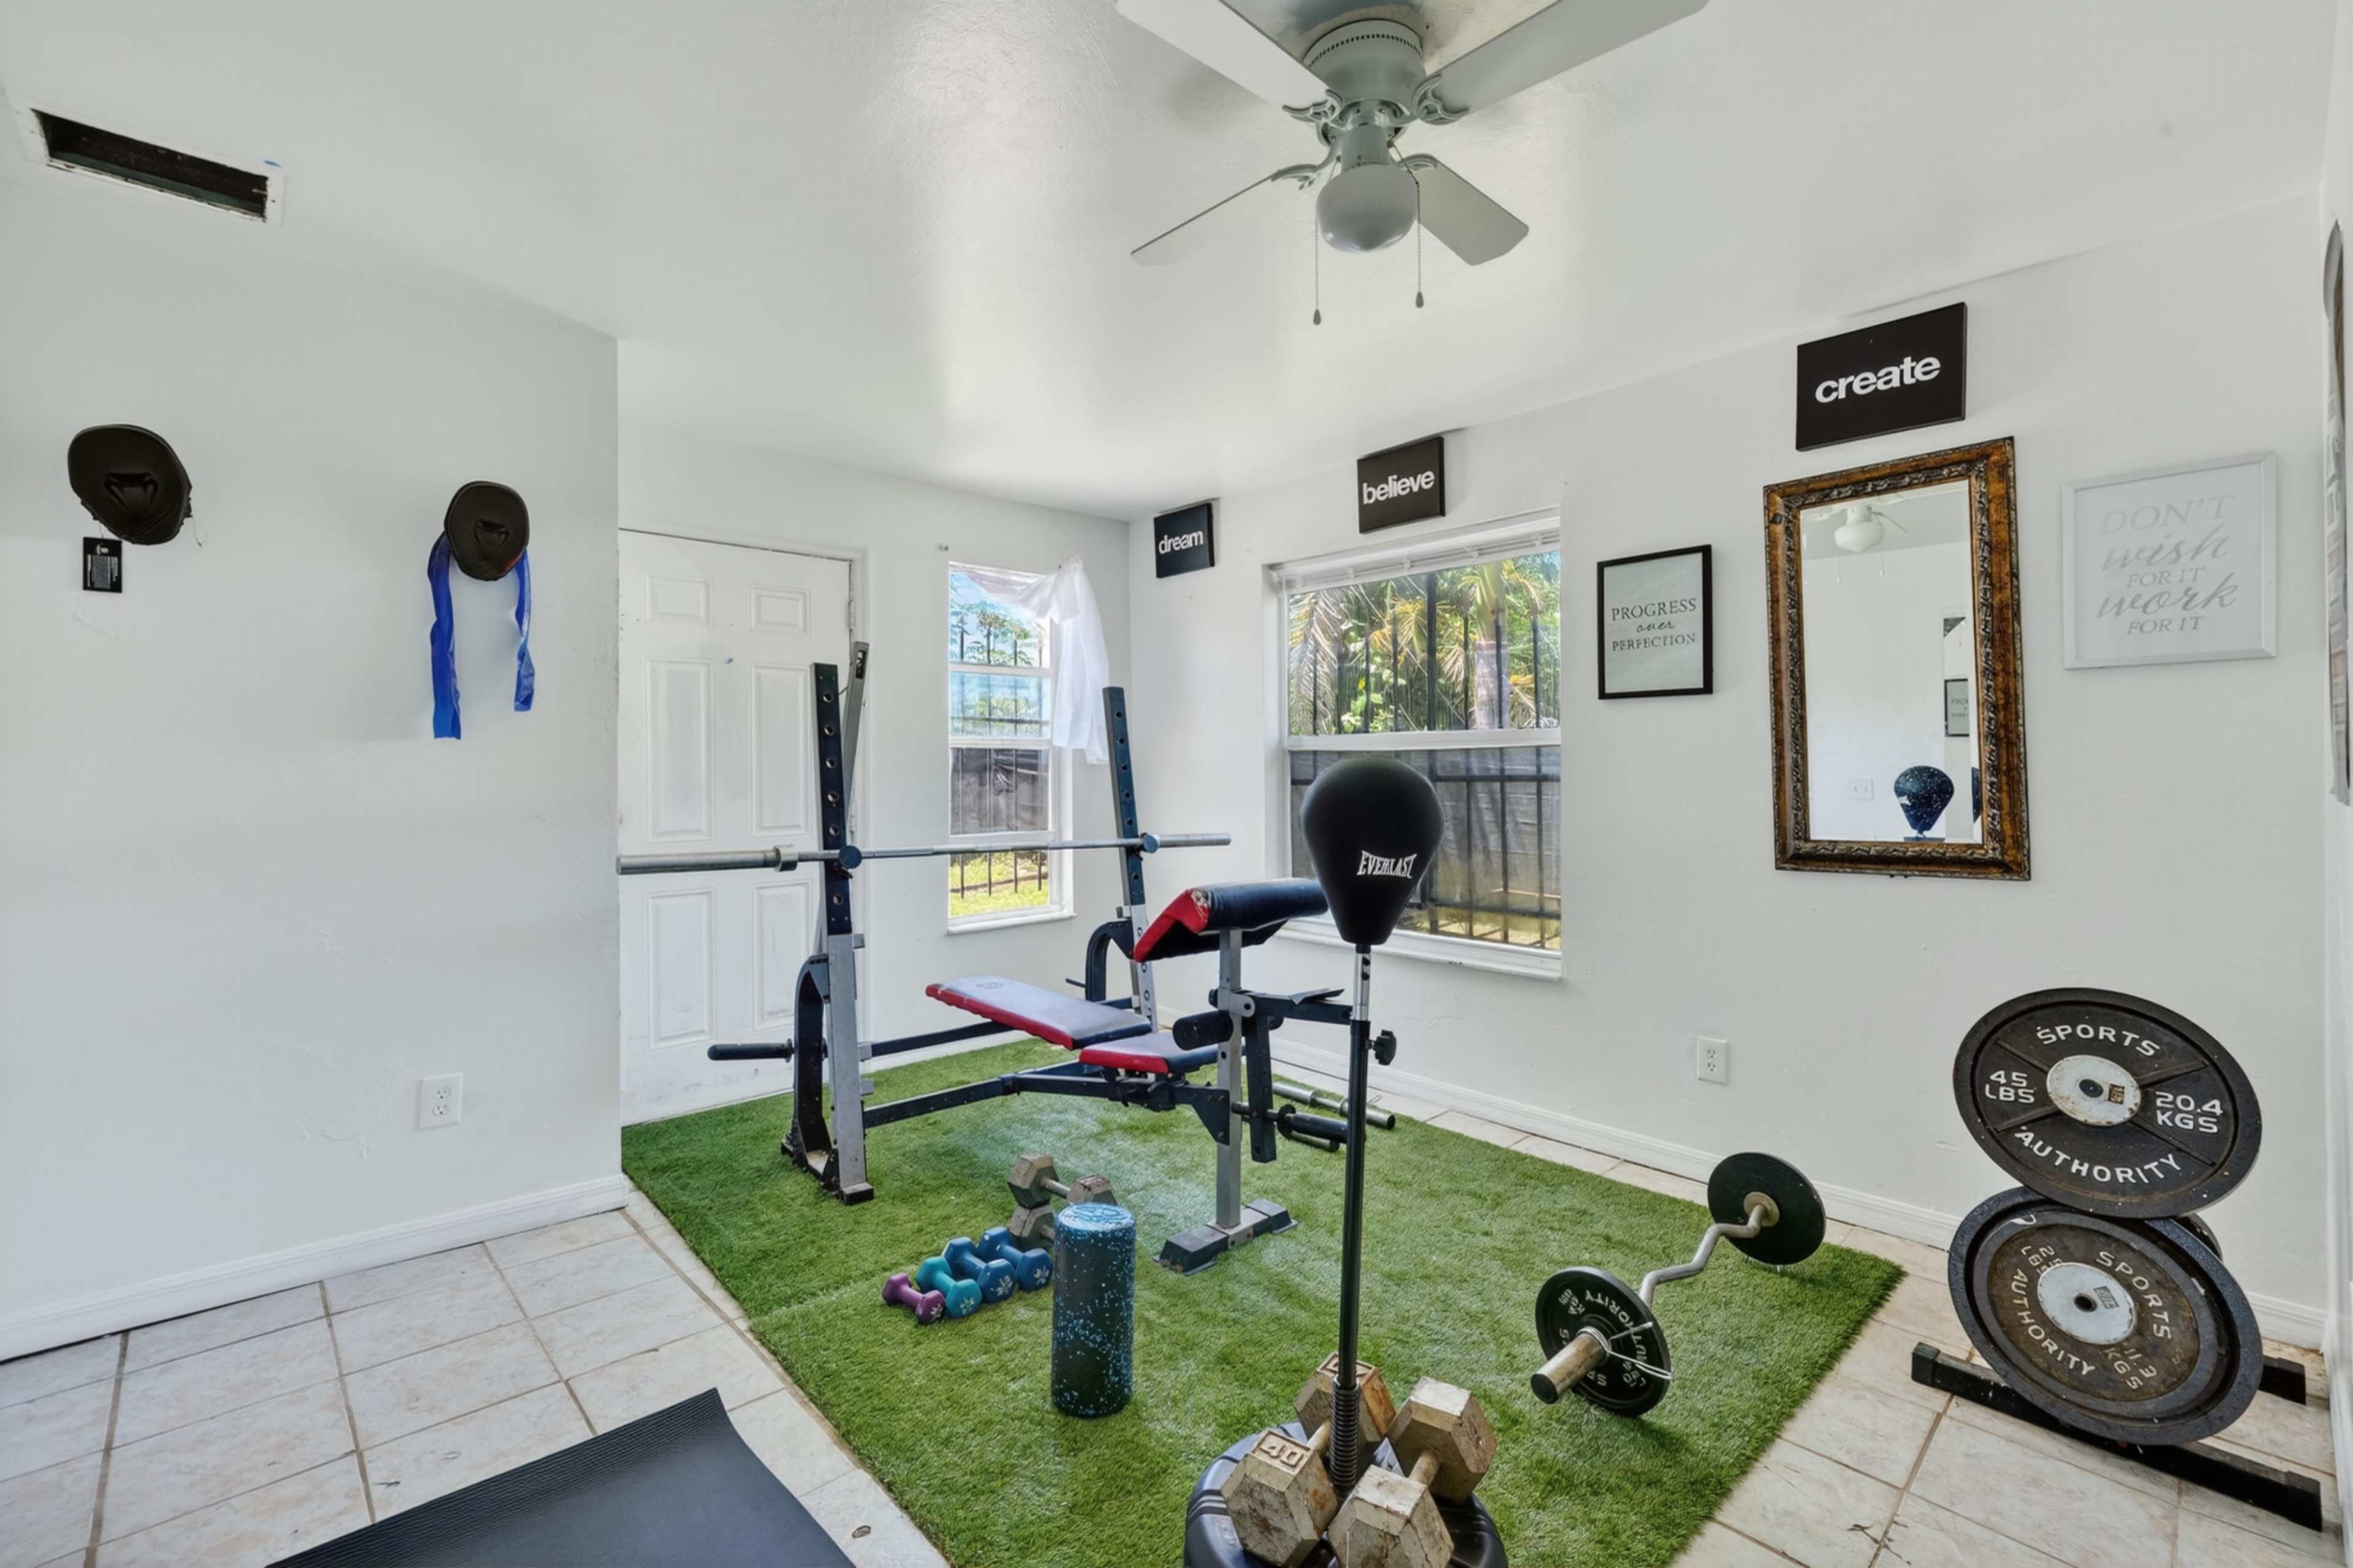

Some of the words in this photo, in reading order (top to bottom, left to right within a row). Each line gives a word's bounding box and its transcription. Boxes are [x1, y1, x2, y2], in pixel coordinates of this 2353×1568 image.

[1814, 355, 1941, 403] create
[1362, 469, 1436, 505] believe
[2100, 494, 2235, 535] DON'T
[1158, 529, 1204, 555] dream
[2101, 523, 2231, 572] wish
[2127, 570, 2172, 588] FOR
[2178, 567, 2205, 583] IT
[1611, 597, 1697, 621] PROGRESS
[2096, 572, 2239, 618] work
[1636, 619, 1676, 633] over
[2127, 618, 2172, 635] FOR
[2179, 615, 2205, 631] IT
[1612, 633, 1696, 652] PERFECTION
[1356, 849, 1418, 879] EVERLAST
[2036, 1024, 2161, 1058] SPORTS
[1989, 1070, 2028, 1088] 45
[1984, 1083, 2036, 1104] LBS
[2154, 1090, 2224, 1116] 20.4
[2155, 1109, 2219, 1134] KGS
[2014, 1127, 2181, 1184] AUTHORITY
[2096, 1251, 2172, 1341] SPORTS
[2010, 1267, 2096, 1377] AUTHORITY
[2102, 1347, 2143, 1390] KGS
[1259, 1442, 1305, 1468] 40
